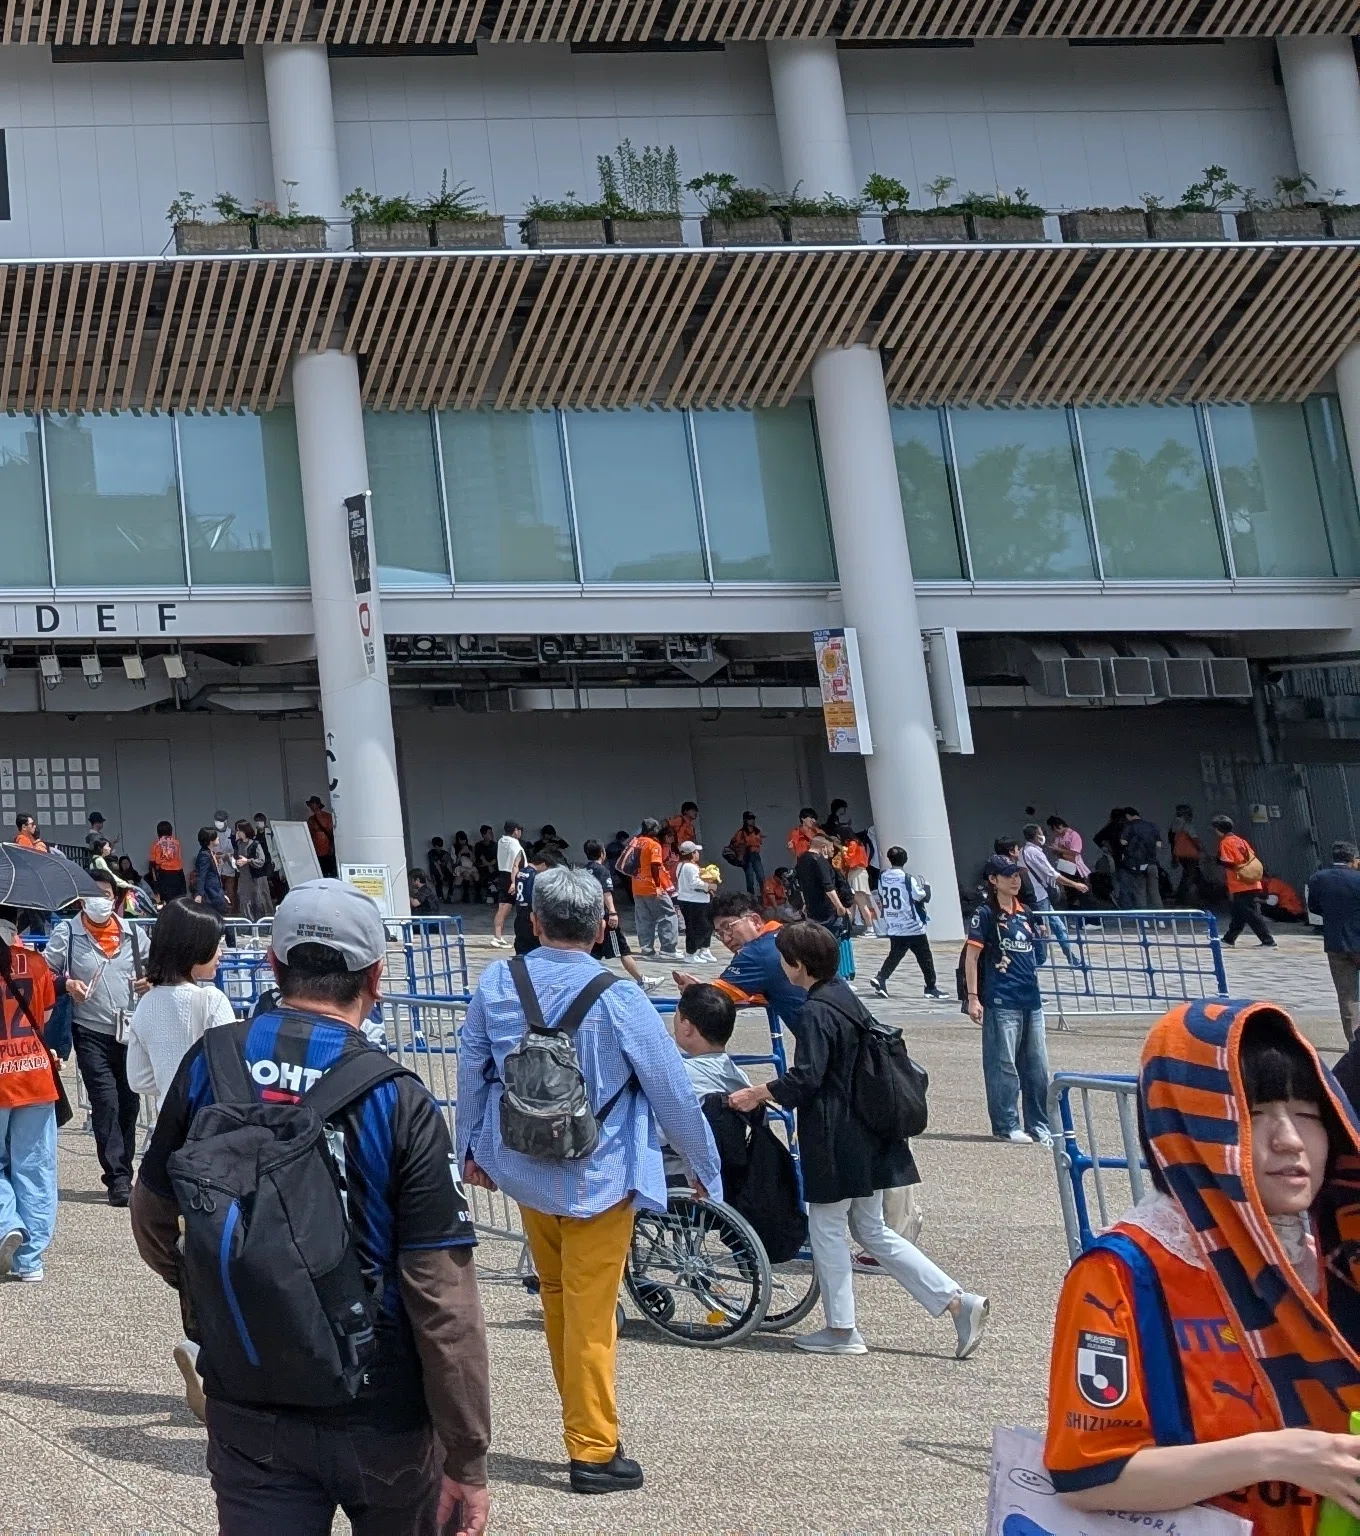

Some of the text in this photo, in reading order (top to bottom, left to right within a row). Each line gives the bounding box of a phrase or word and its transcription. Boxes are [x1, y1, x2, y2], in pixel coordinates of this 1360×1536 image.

[36, 604, 60, 633] D
[97, 604, 117, 632] E
[157, 603, 177, 632] F
